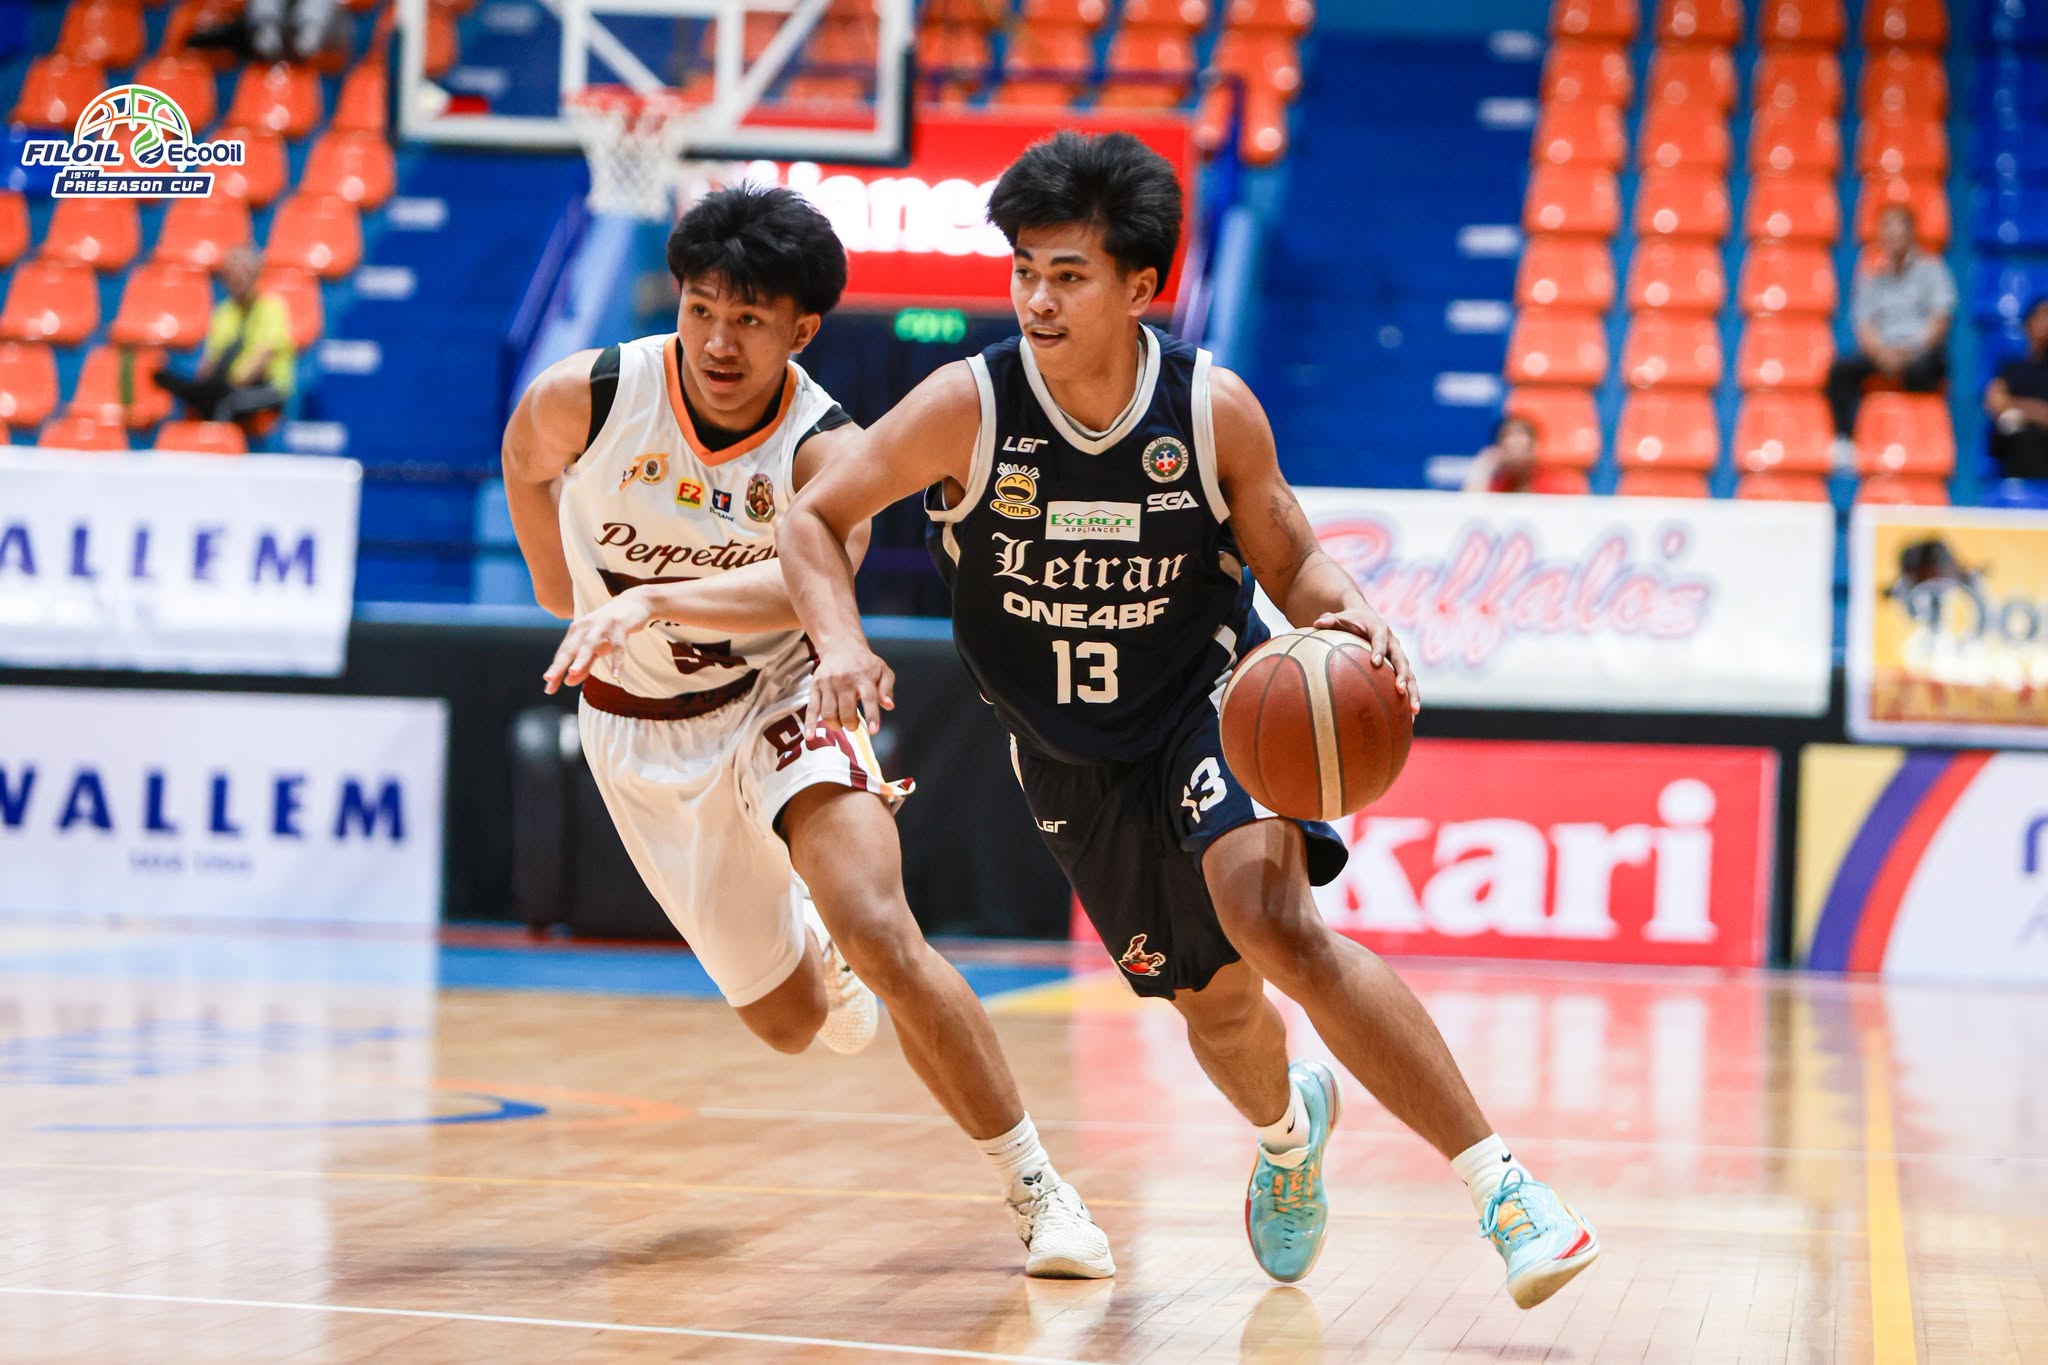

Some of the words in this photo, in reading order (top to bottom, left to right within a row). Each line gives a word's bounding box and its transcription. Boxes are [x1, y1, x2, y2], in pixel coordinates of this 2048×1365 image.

[678, 482, 702, 502] F2
[1146, 490, 1199, 512] SGA
[1051, 514, 1135, 526] EVEREST
[594, 522, 778, 576] Perpetua
[991, 532, 1188, 592] Letran
[1003, 591, 1170, 629] ONE4BF
[1052, 640, 1118, 704] 13
